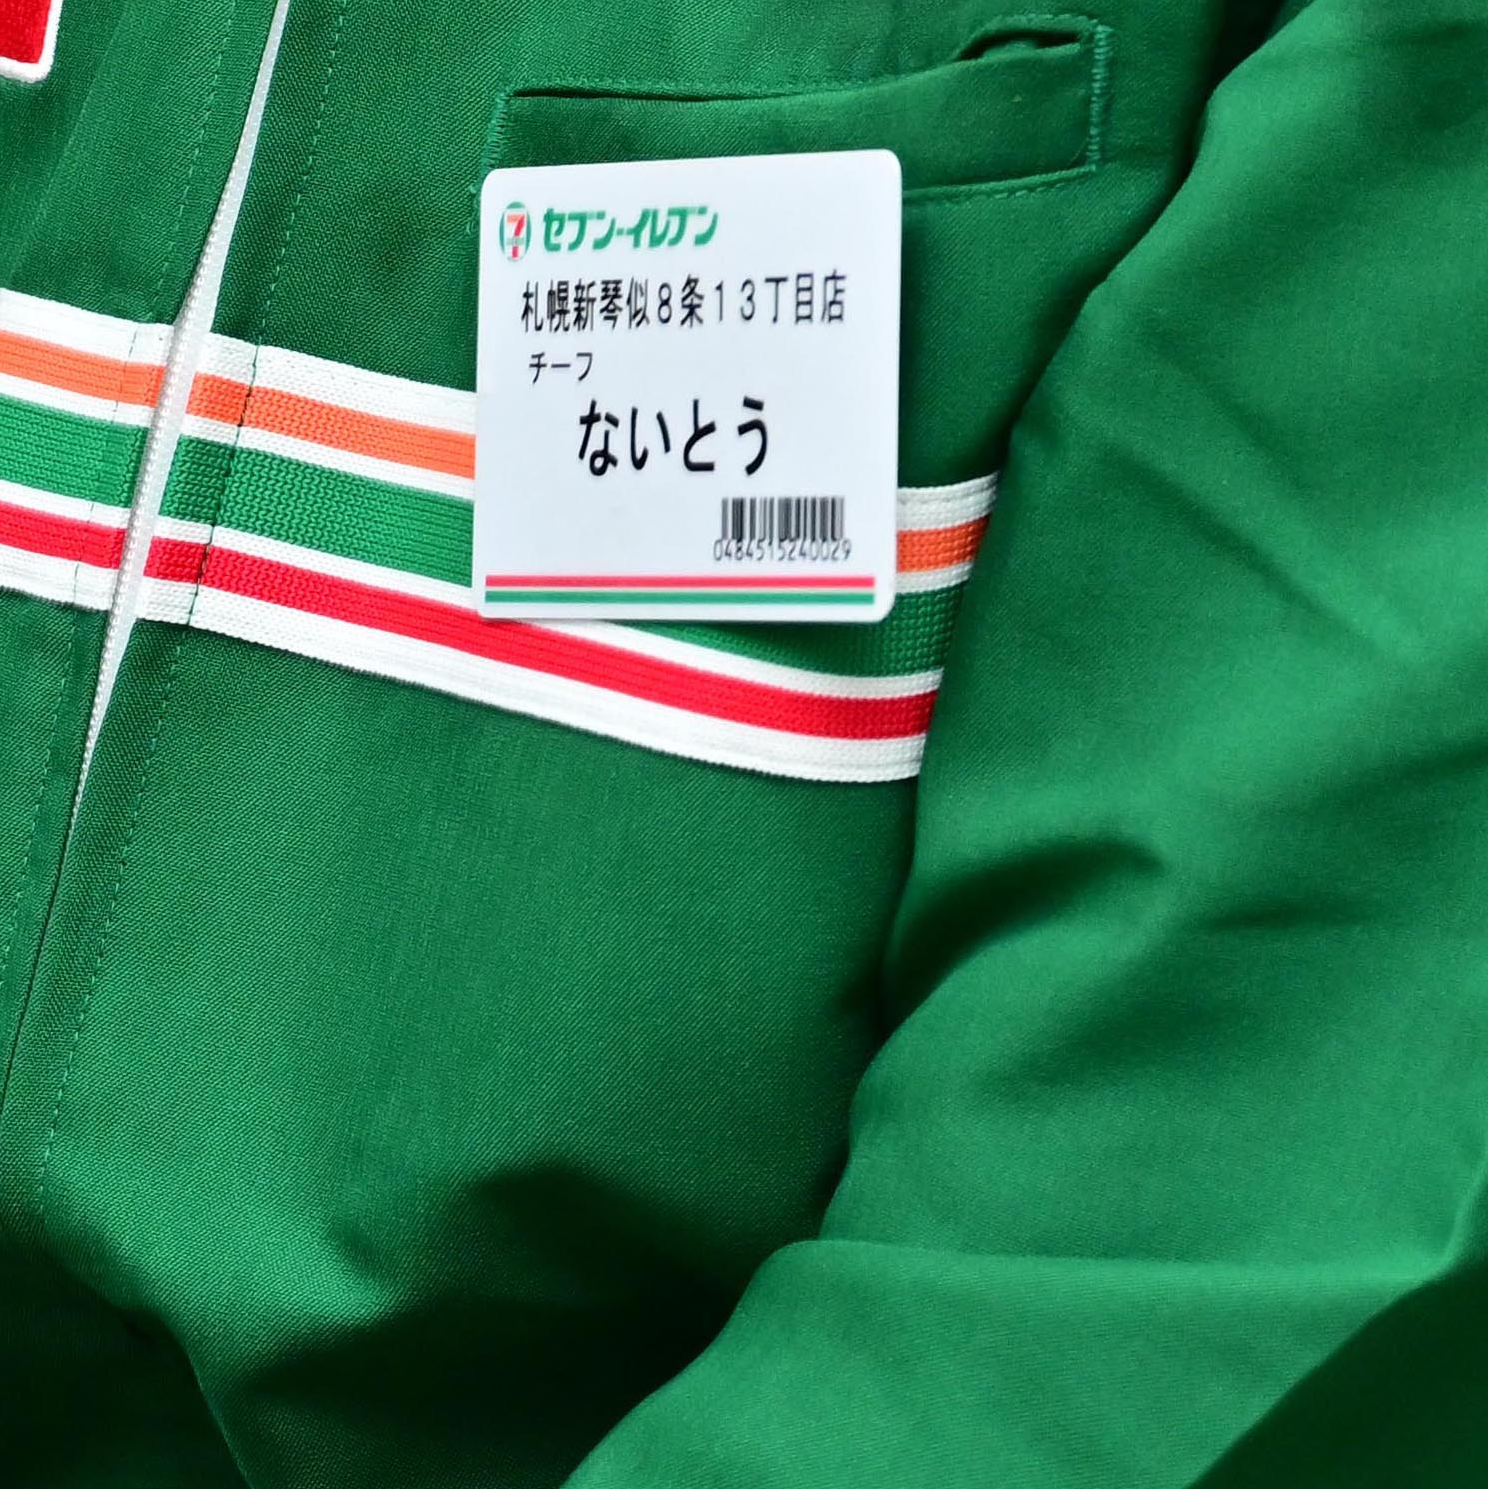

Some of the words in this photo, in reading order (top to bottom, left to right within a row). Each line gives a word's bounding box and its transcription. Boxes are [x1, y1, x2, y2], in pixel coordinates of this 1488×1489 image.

[521, 269, 846, 332] 札幌新琴似8条13丁目店
[529, 352, 593, 384] チーフ
[578, 397, 769, 476] ないとう
[713, 539, 852, 562] 0484515240029
